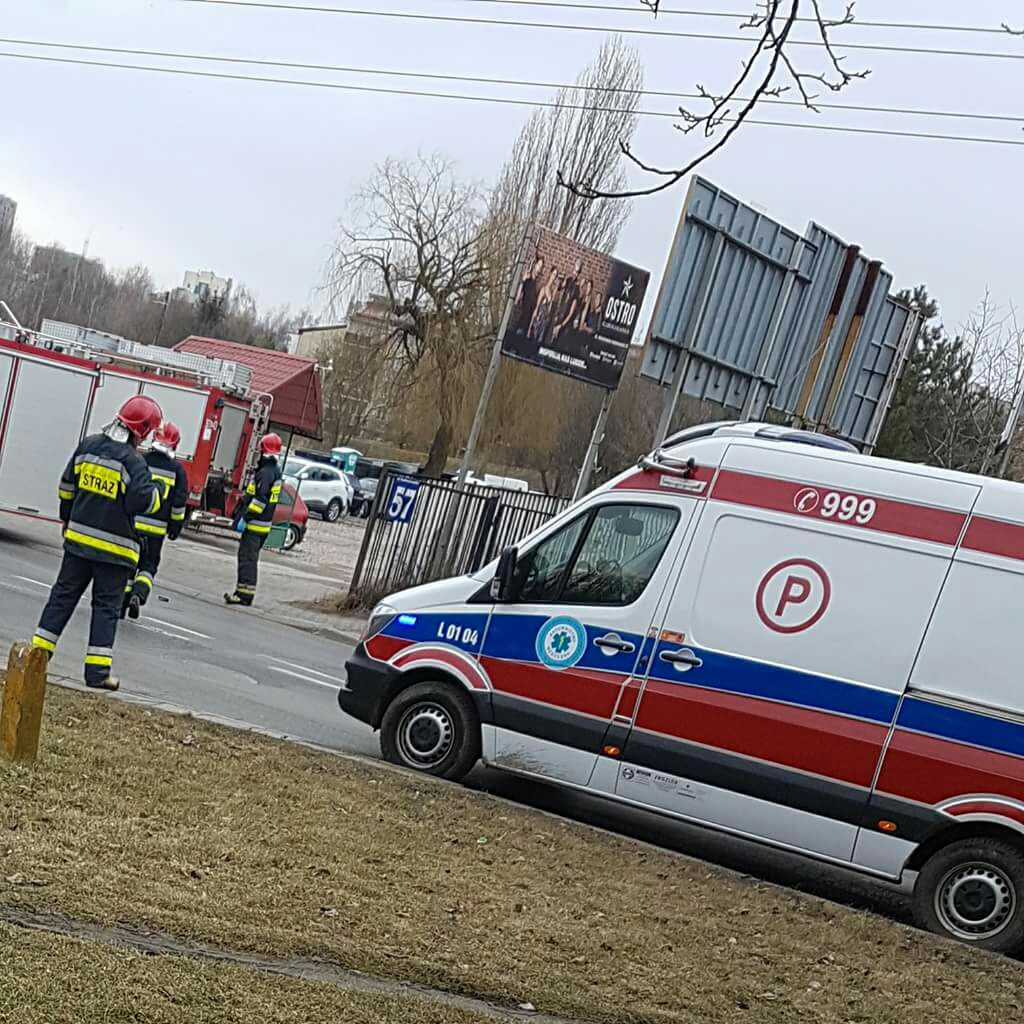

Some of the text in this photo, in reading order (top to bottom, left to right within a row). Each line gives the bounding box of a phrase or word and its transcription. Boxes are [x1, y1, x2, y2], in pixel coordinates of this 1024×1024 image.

[605, 296, 636, 325] OSTRO
[388, 486, 417, 520] 57
[819, 491, 876, 525] 999
[775, 575, 812, 617] P
[437, 622, 444, 638] L
